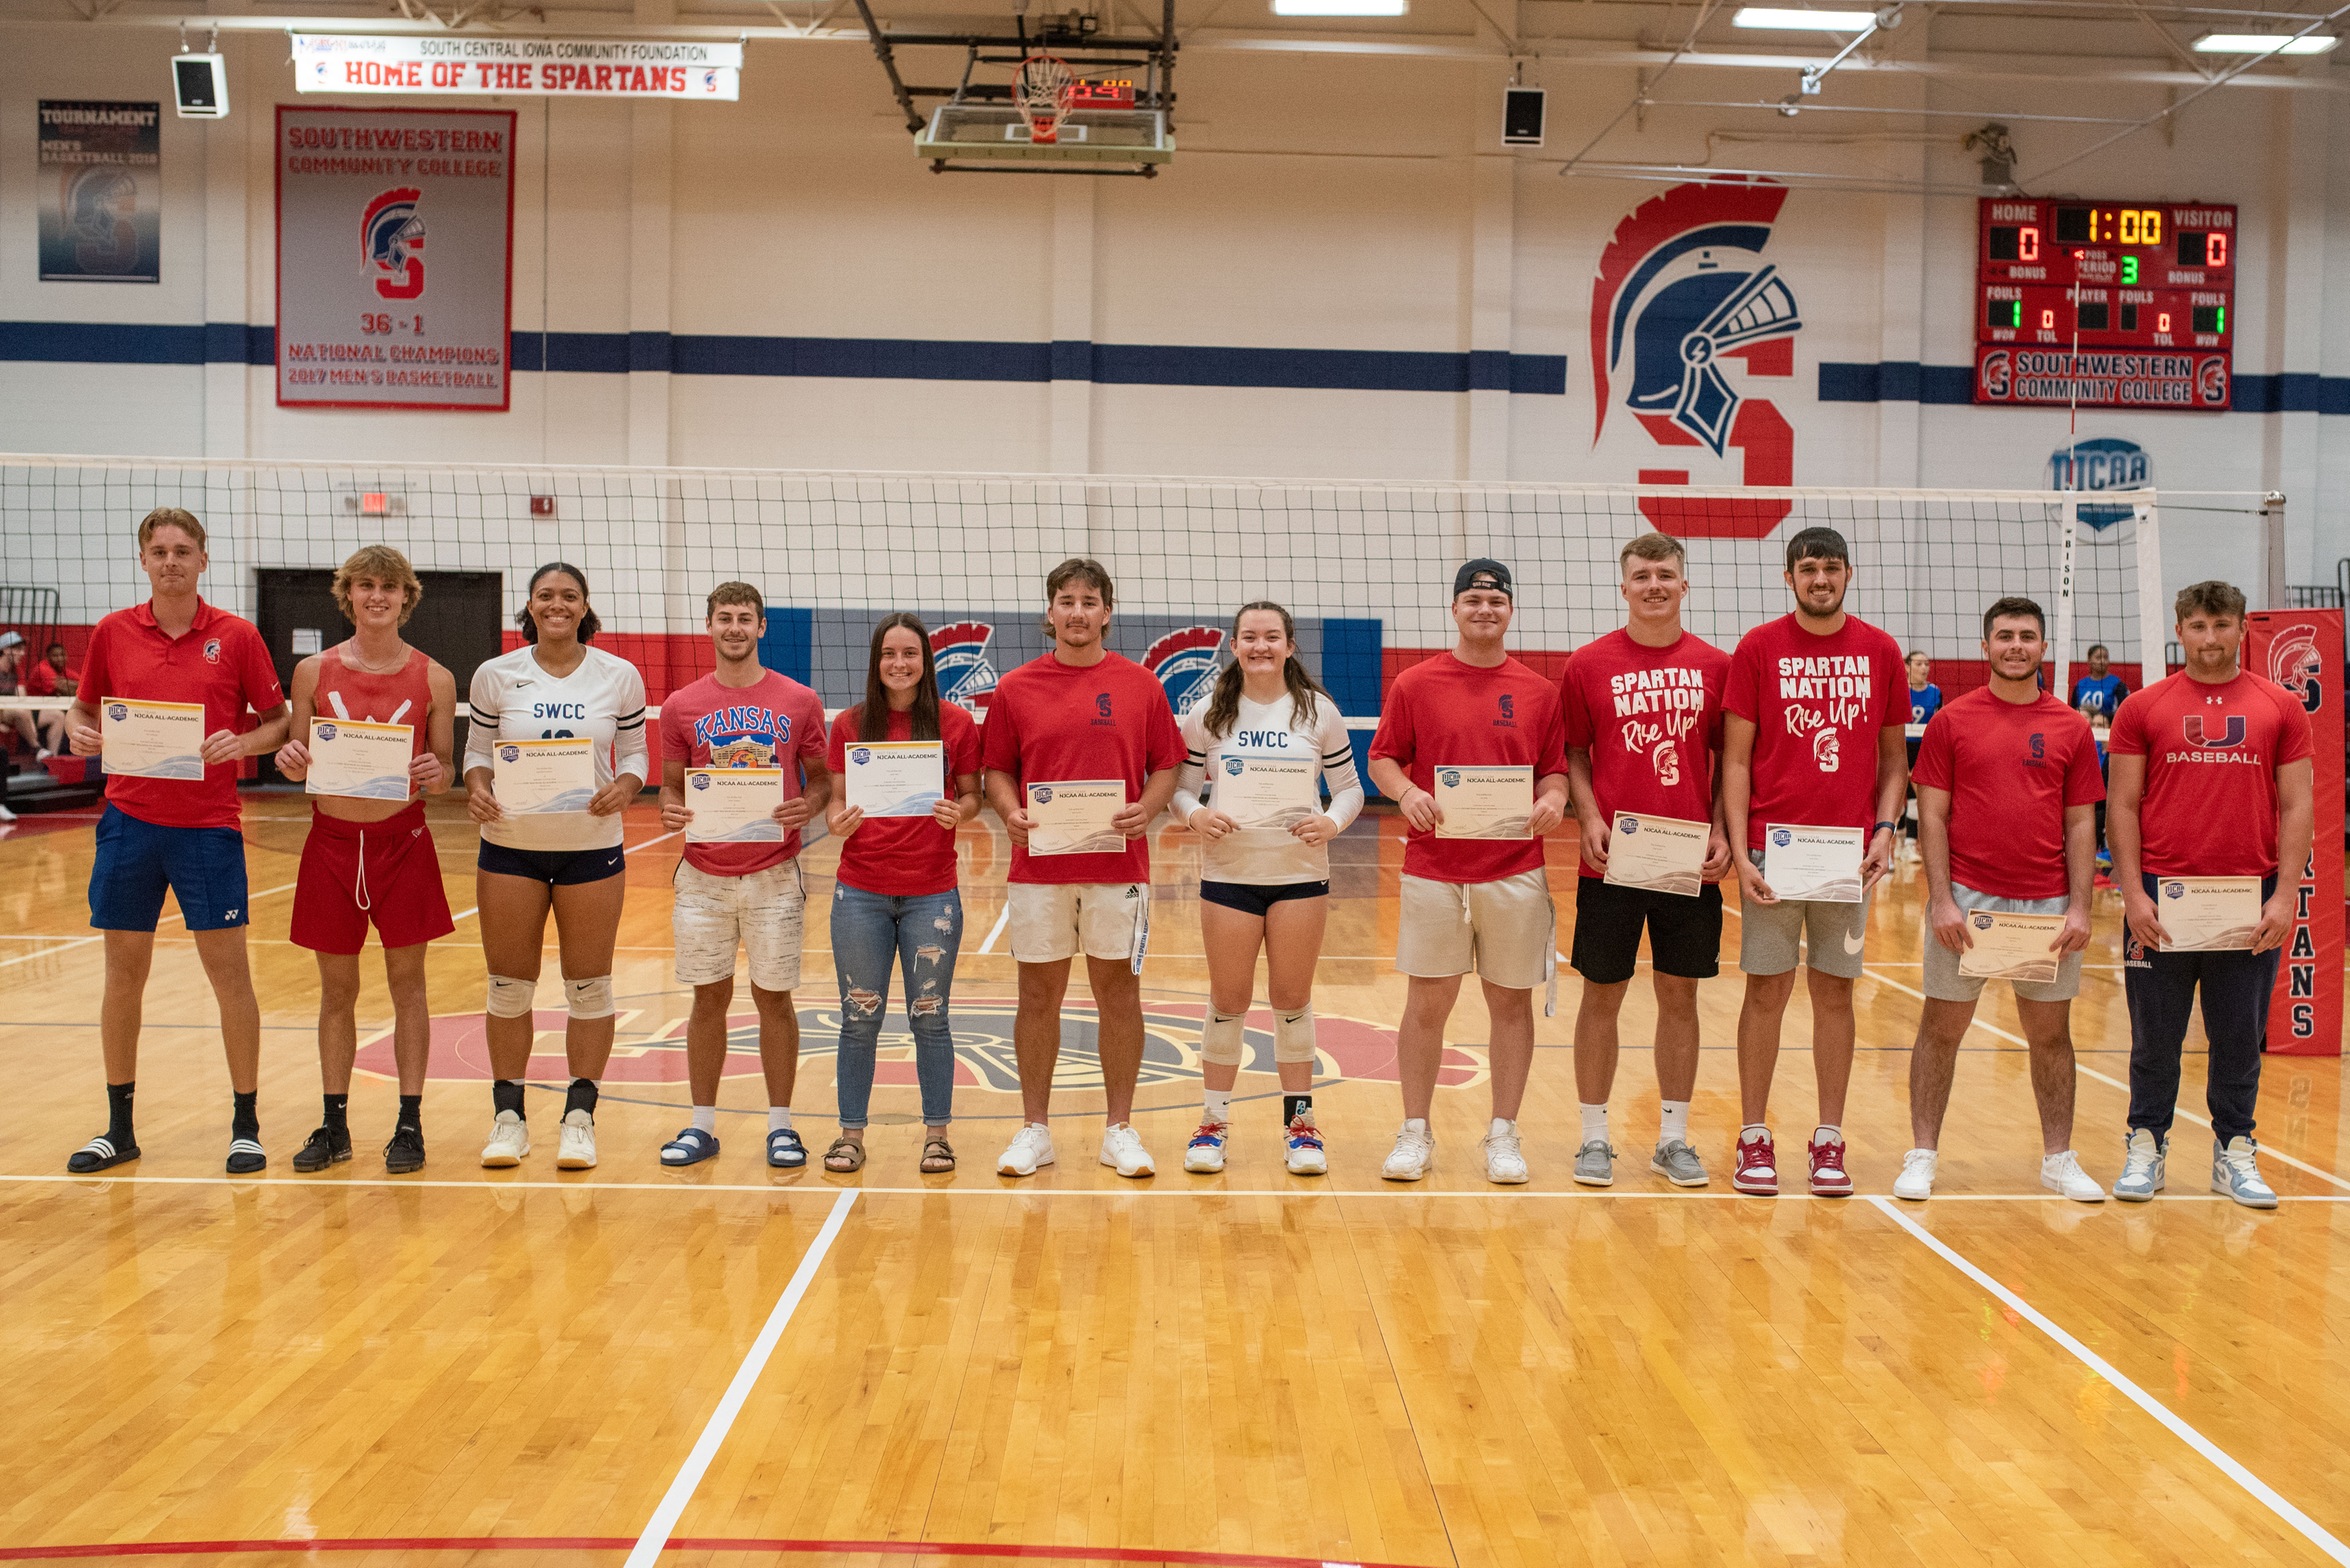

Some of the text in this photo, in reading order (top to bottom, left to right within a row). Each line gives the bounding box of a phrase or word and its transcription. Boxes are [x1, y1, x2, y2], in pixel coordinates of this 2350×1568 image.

[420, 40, 708, 61] SOUTH CENTRAL IOWA COMMUNITY FOUNDATION
[345, 61, 687, 92] HOME OF THE SPARTANS
[41, 109, 156, 127] TOURNAMENT
[288, 127, 502, 153] SOUTHWESTERN
[288, 156, 501, 178] COMMUNITY COLLEGE
[1992, 204, 2232, 245] HOME 1:00 VISITOR
[2019, 227, 2039, 261] 0
[2206, 233, 2227, 267] 0
[2009, 266, 2046, 279] BONUS
[2121, 255, 2139, 284] 3
[2168, 271, 2205, 284] BONUS
[1986, 287, 2022, 300] FOULS
[2119, 290, 2153, 304] FOULS
[2191, 293, 2225, 306] FOULS
[360, 313, 392, 335] 36
[413, 315, 424, 336] 1
[2013, 300, 2021, 328] 1
[2042, 310, 2054, 329] 0
[2158, 313, 2170, 332] 0
[2216, 306, 2225, 334] 1
[2037, 330, 2058, 343] TOL
[2153, 333, 2174, 346] TOL
[288, 344, 499, 365] NATIONAL CHAMPIONS
[2017, 353, 2192, 377] SOUTHWESTERN
[288, 368, 326, 385] 2017
[386, 370, 497, 388] BASKETBALL
[2016, 378, 2192, 402] COMMUNITY COLLEGE
[2062, 540, 2072, 598] BISON
[1778, 656, 1870, 677] SPARTAN
[1611, 668, 1704, 695] SPARTAN
[1780, 676, 1871, 699] NATION
[533, 703, 585, 720] SWCC
[1613, 688, 1705, 718] NATION
[1784, 692, 1868, 738] Rise Up!
[694, 705, 792, 748] KANSAS
[1621, 703, 1700, 754] Rise Up!
[2183, 715, 2246, 749] U
[364, 735, 407, 743] ALL-ACADEMIC
[1238, 731, 1288, 748] SWCC
[2166, 751, 2261, 765] BASEBALL
[1662, 830, 1701, 839] ALL-ACADEMIC
